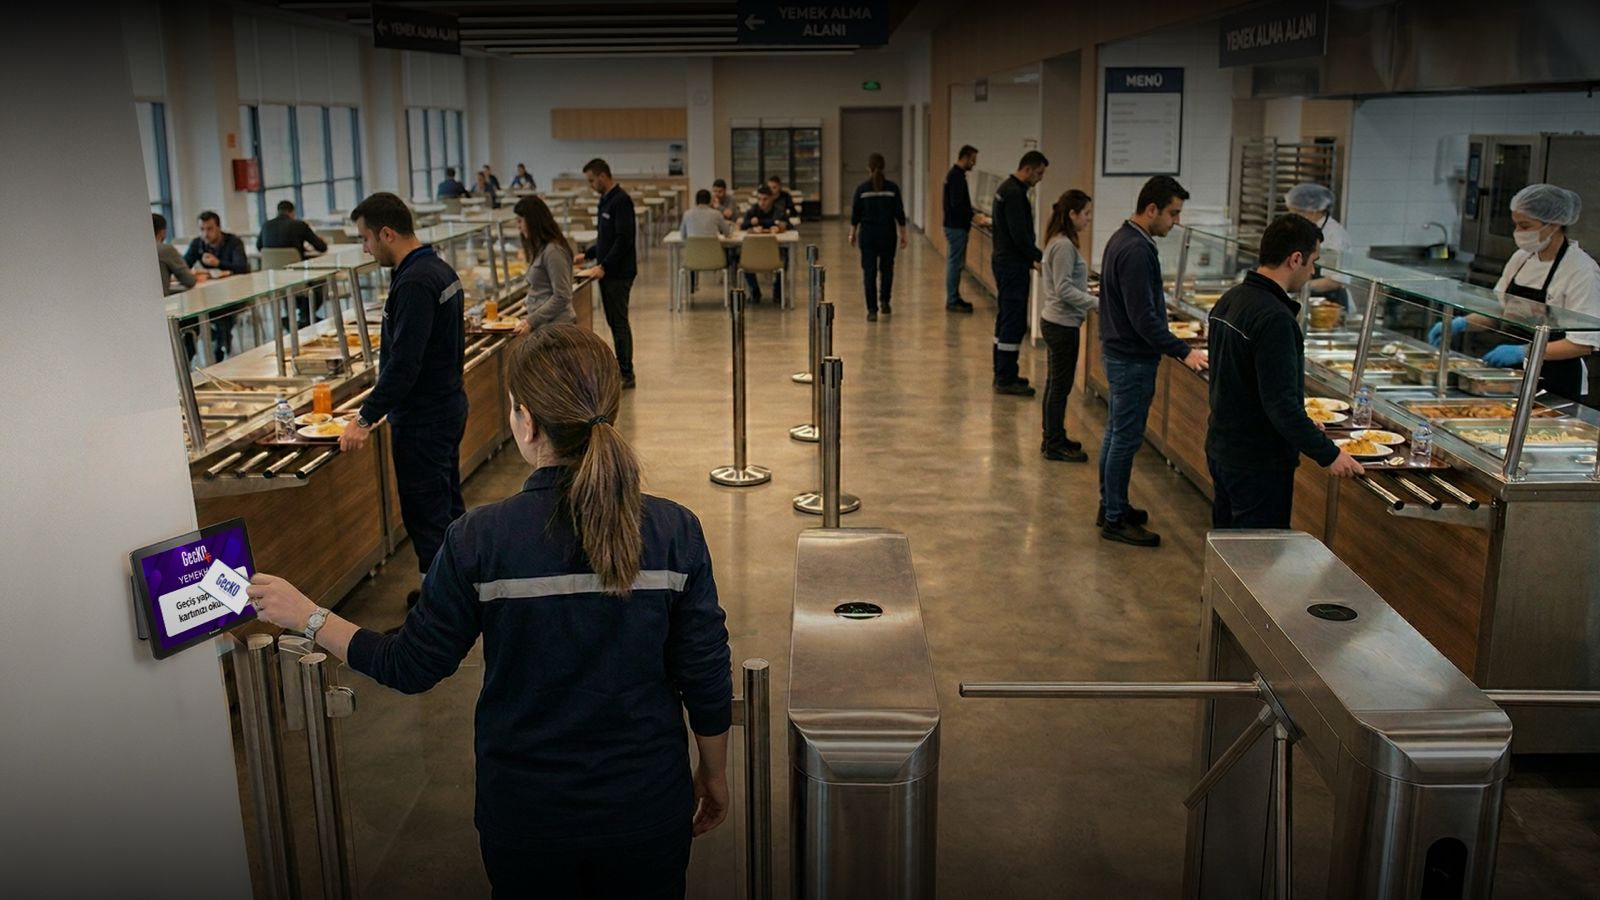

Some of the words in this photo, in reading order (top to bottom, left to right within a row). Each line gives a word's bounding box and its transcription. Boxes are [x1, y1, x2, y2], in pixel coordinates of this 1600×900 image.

[778, 6, 828, 19] YEMEK
[830, 7, 872, 19] ALMA
[802, 23, 846, 36] ALANI
[1226, 25, 1256, 52] YEMEK
[1256, 19, 1284, 47] ALMA
[1284, 12, 1317, 43] ALANI
[1125, 72, 1163, 88] MENÜ
[178, 567, 210, 585] YEMEKH
[176, 596, 196, 610] Geçiş
[196, 593, 212, 605] yap
[178, 605, 208, 623] kartınızı
[208, 600, 225, 611] oku
